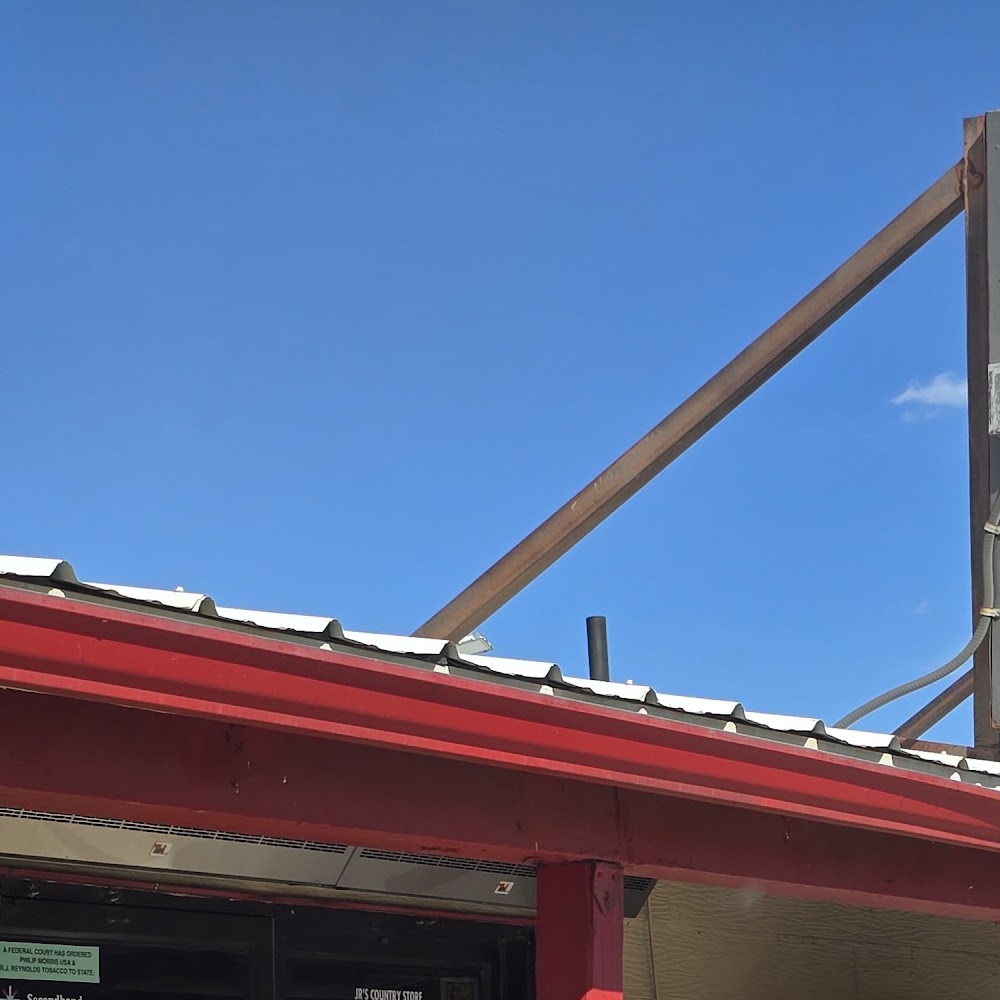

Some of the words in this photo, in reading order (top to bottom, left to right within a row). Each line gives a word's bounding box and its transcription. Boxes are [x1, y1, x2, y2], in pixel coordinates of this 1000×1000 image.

[3, 946, 8, 954] A
[8, 947, 33, 955] FEDERAL
[34, 948, 53, 956] COURT
[66, 951, 92, 959] ORDERED
[38, 958, 59, 966] MORRIS
[42, 967, 67, 975] TOBACCO
[354, 987, 369, 1000] JR'S
